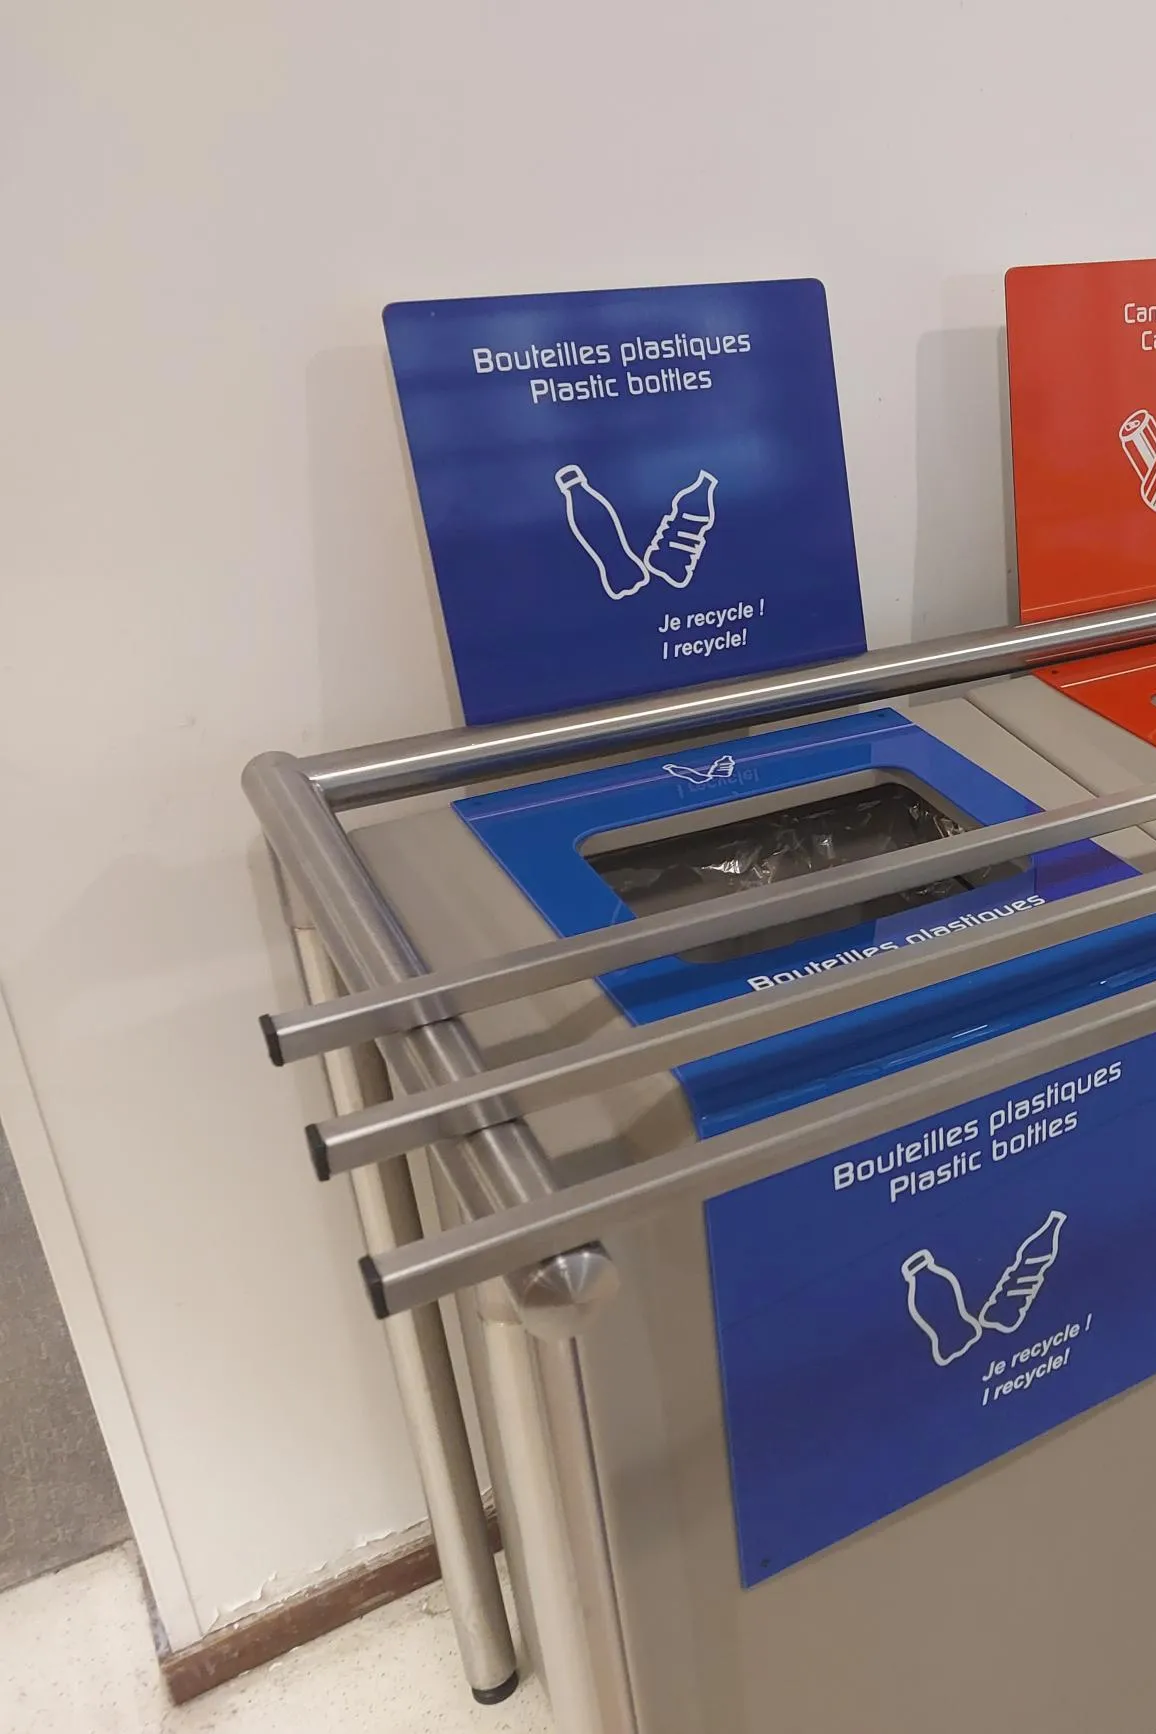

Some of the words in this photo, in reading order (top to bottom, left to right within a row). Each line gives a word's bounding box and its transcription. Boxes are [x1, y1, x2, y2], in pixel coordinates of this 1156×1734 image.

[473, 342, 611, 374] Bouteilles
[621, 333, 751, 367] plastiques
[530, 374, 619, 404] Plastic
[626, 367, 713, 396] bottles
[658, 614, 681, 633] Je
[686, 602, 754, 628] recycle
[663, 642, 668, 660] I
[674, 628, 747, 657] recycle!
[747, 941, 899, 992] Bouteilles
[833, 1119, 979, 1191] Bouteilles
[989, 1061, 1122, 1136] plastiques
[889, 1151, 982, 1203] Plastic
[992, 1111, 1078, 1162] bottles
[982, 1361, 1006, 1382] Je
[1010, 1323, 1080, 1368] recycle
[982, 1387, 990, 1406] I
[993, 1347, 1071, 1401] recycle!
